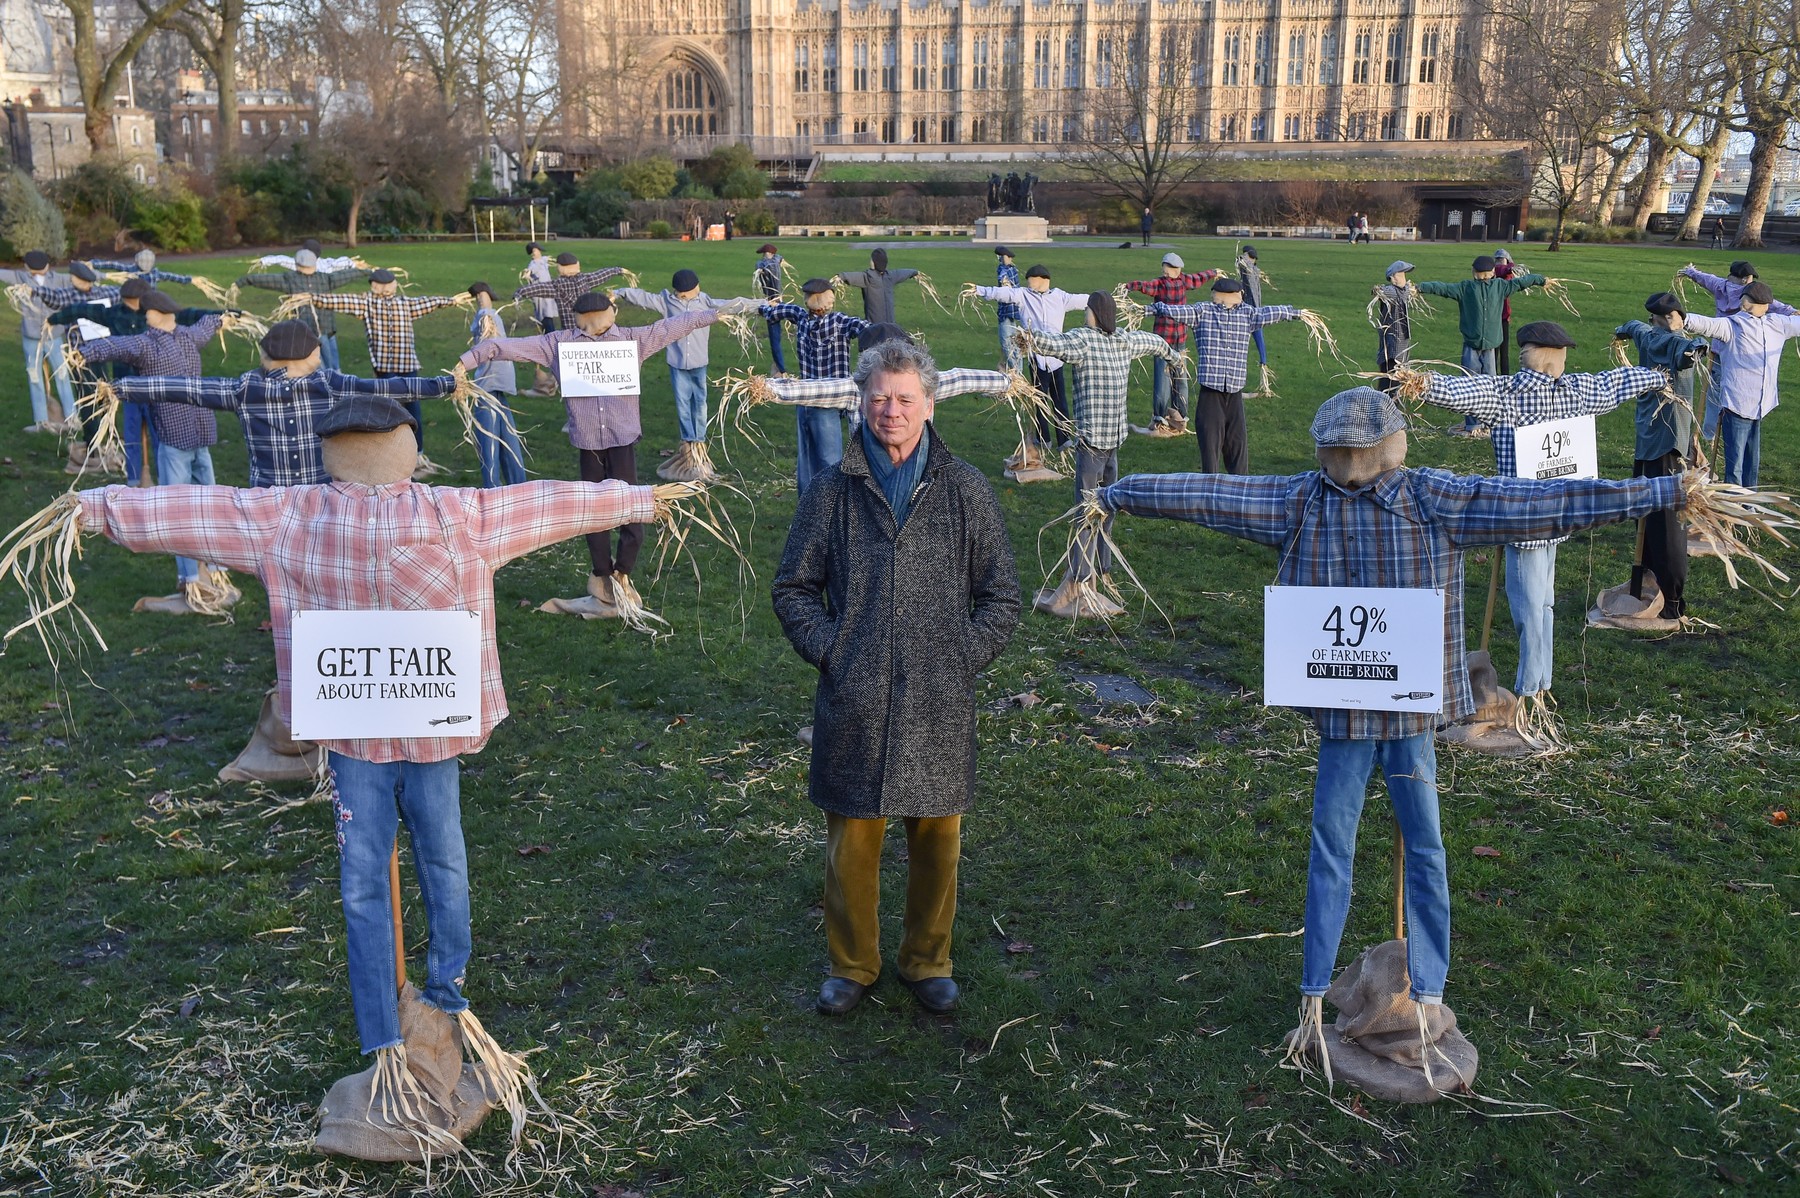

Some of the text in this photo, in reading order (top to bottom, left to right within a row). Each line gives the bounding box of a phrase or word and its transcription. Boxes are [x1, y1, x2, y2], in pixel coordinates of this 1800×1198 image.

[576, 361, 604, 374] FAIR
[591, 374, 631, 383] FARMERS
[1541, 430, 1571, 458] 49%
[1537, 465, 1575, 479] ON THE BRINK
[1538, 461, 1546, 469] OF
[1322, 605, 1387, 647] 49%
[1312, 649, 1327, 660] OF
[317, 647, 457, 677] GET FAIR
[1309, 664, 1395, 679] ON THE BRINK
[316, 682, 456, 699] ABOUT FARMING
